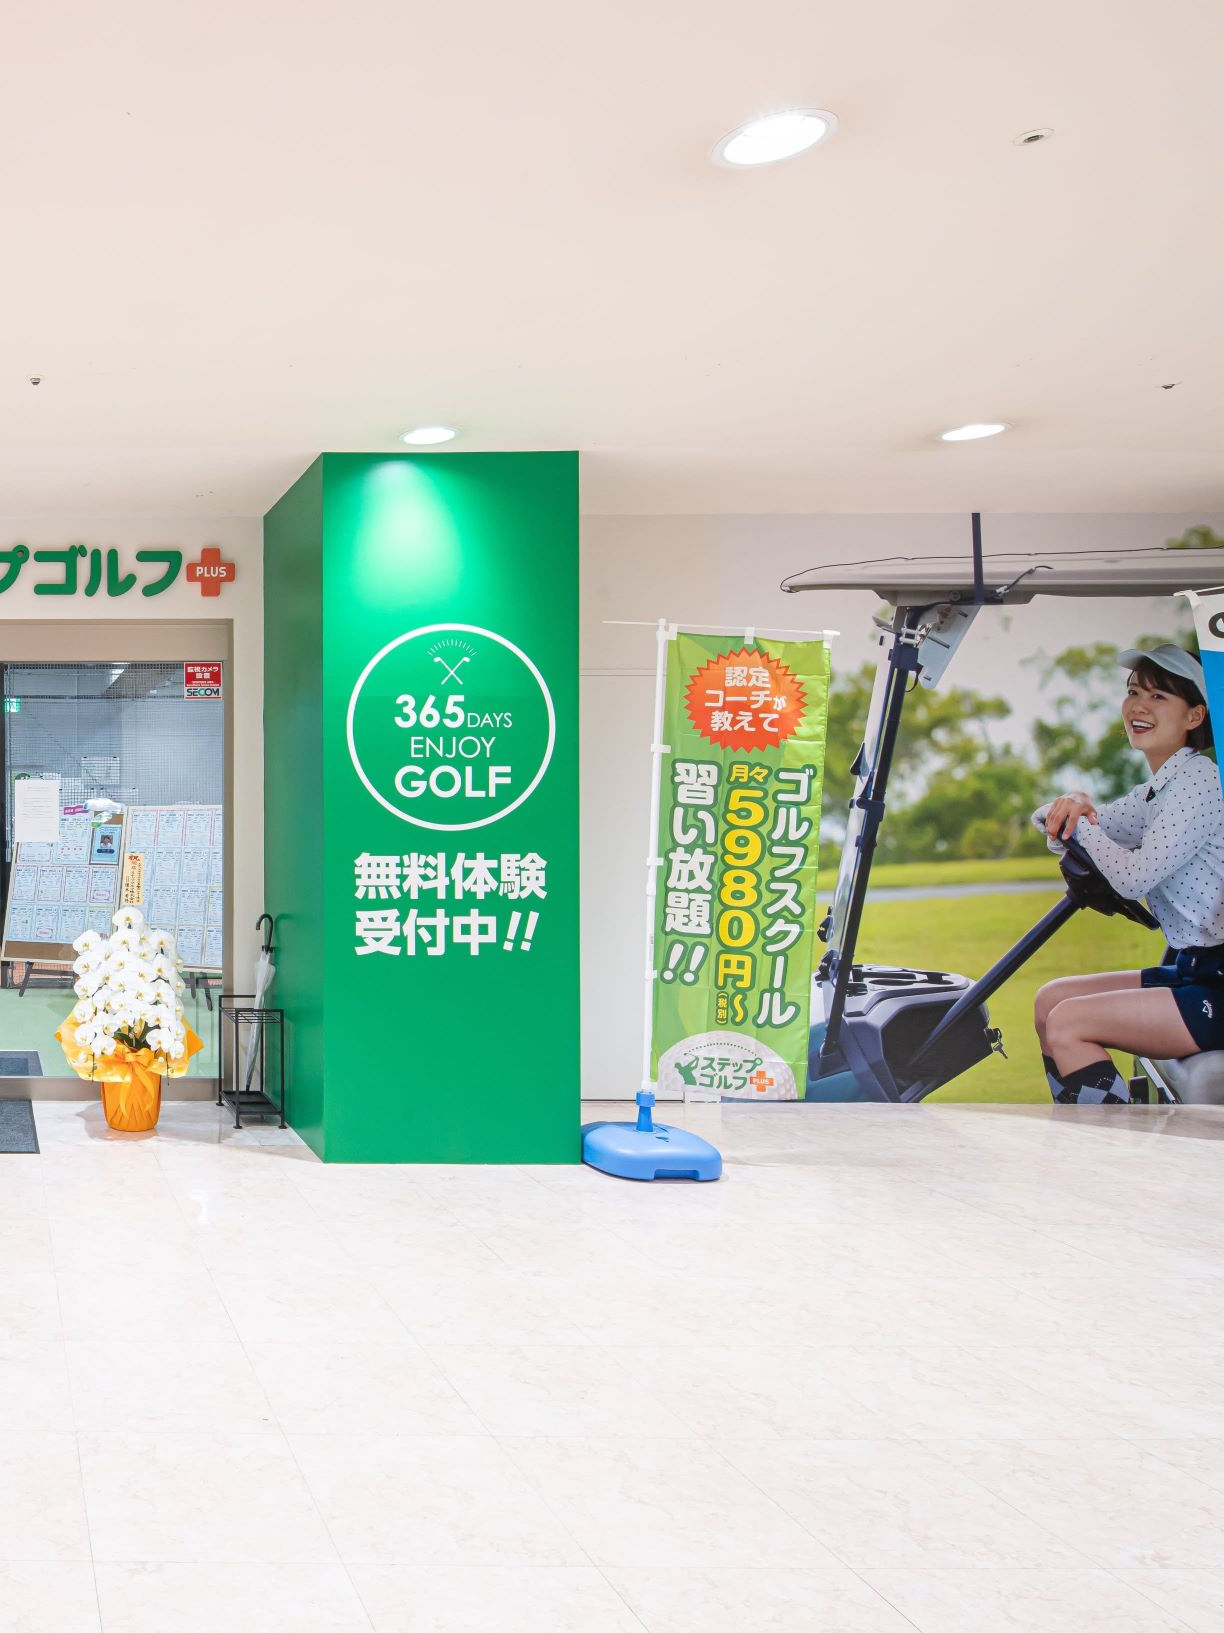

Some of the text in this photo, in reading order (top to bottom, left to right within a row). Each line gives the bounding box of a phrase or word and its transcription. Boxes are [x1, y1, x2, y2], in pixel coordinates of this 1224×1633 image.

[196, 566, 227, 578] PLUS
[724, 666, 772, 688] 認定
[187, 688, 219, 696] SECOM
[704, 689, 787, 711] コーチが
[394, 694, 513, 729] 365 DAYS
[710, 710, 779, 733] 教えて
[410, 736, 496, 759] ENJOY
[394, 765, 512, 798] GOLF
[354, 852, 548, 900] 無料体験
[757, 768, 814, 1025] ゴルフスクール
[701, 1056, 764, 1074] ステップ
[698, 1074, 748, 1091] ゴルフ
